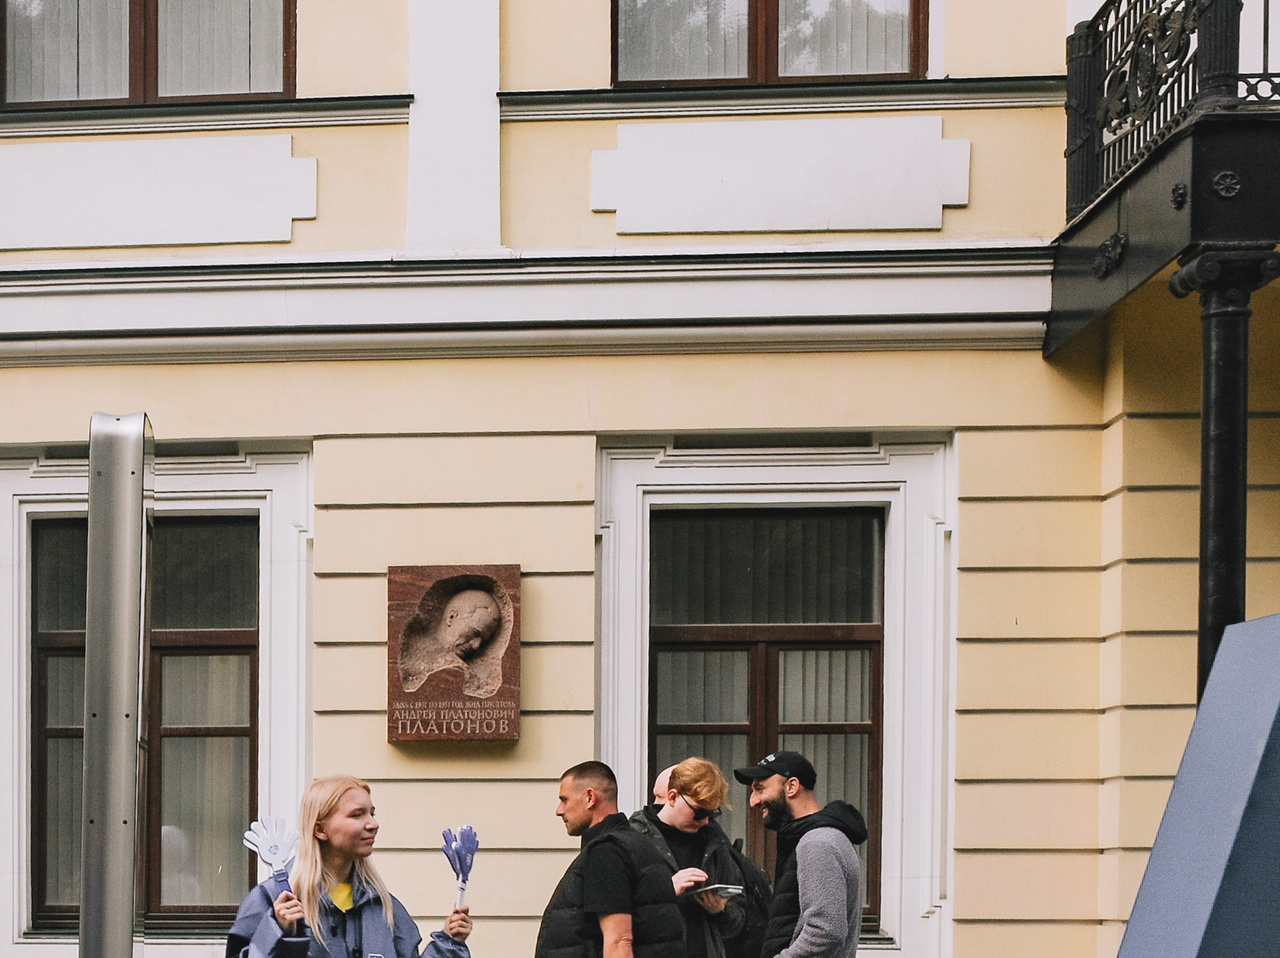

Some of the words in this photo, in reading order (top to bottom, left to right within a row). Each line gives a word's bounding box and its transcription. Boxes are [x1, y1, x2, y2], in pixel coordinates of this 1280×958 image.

[451, 701, 464, 709] ГОД
[393, 709, 436, 719] АНДРЕЙ
[441, 709, 515, 719] ПЛАТОНОВИЧ
[398, 719, 509, 734] ПЛАТОНОВ
